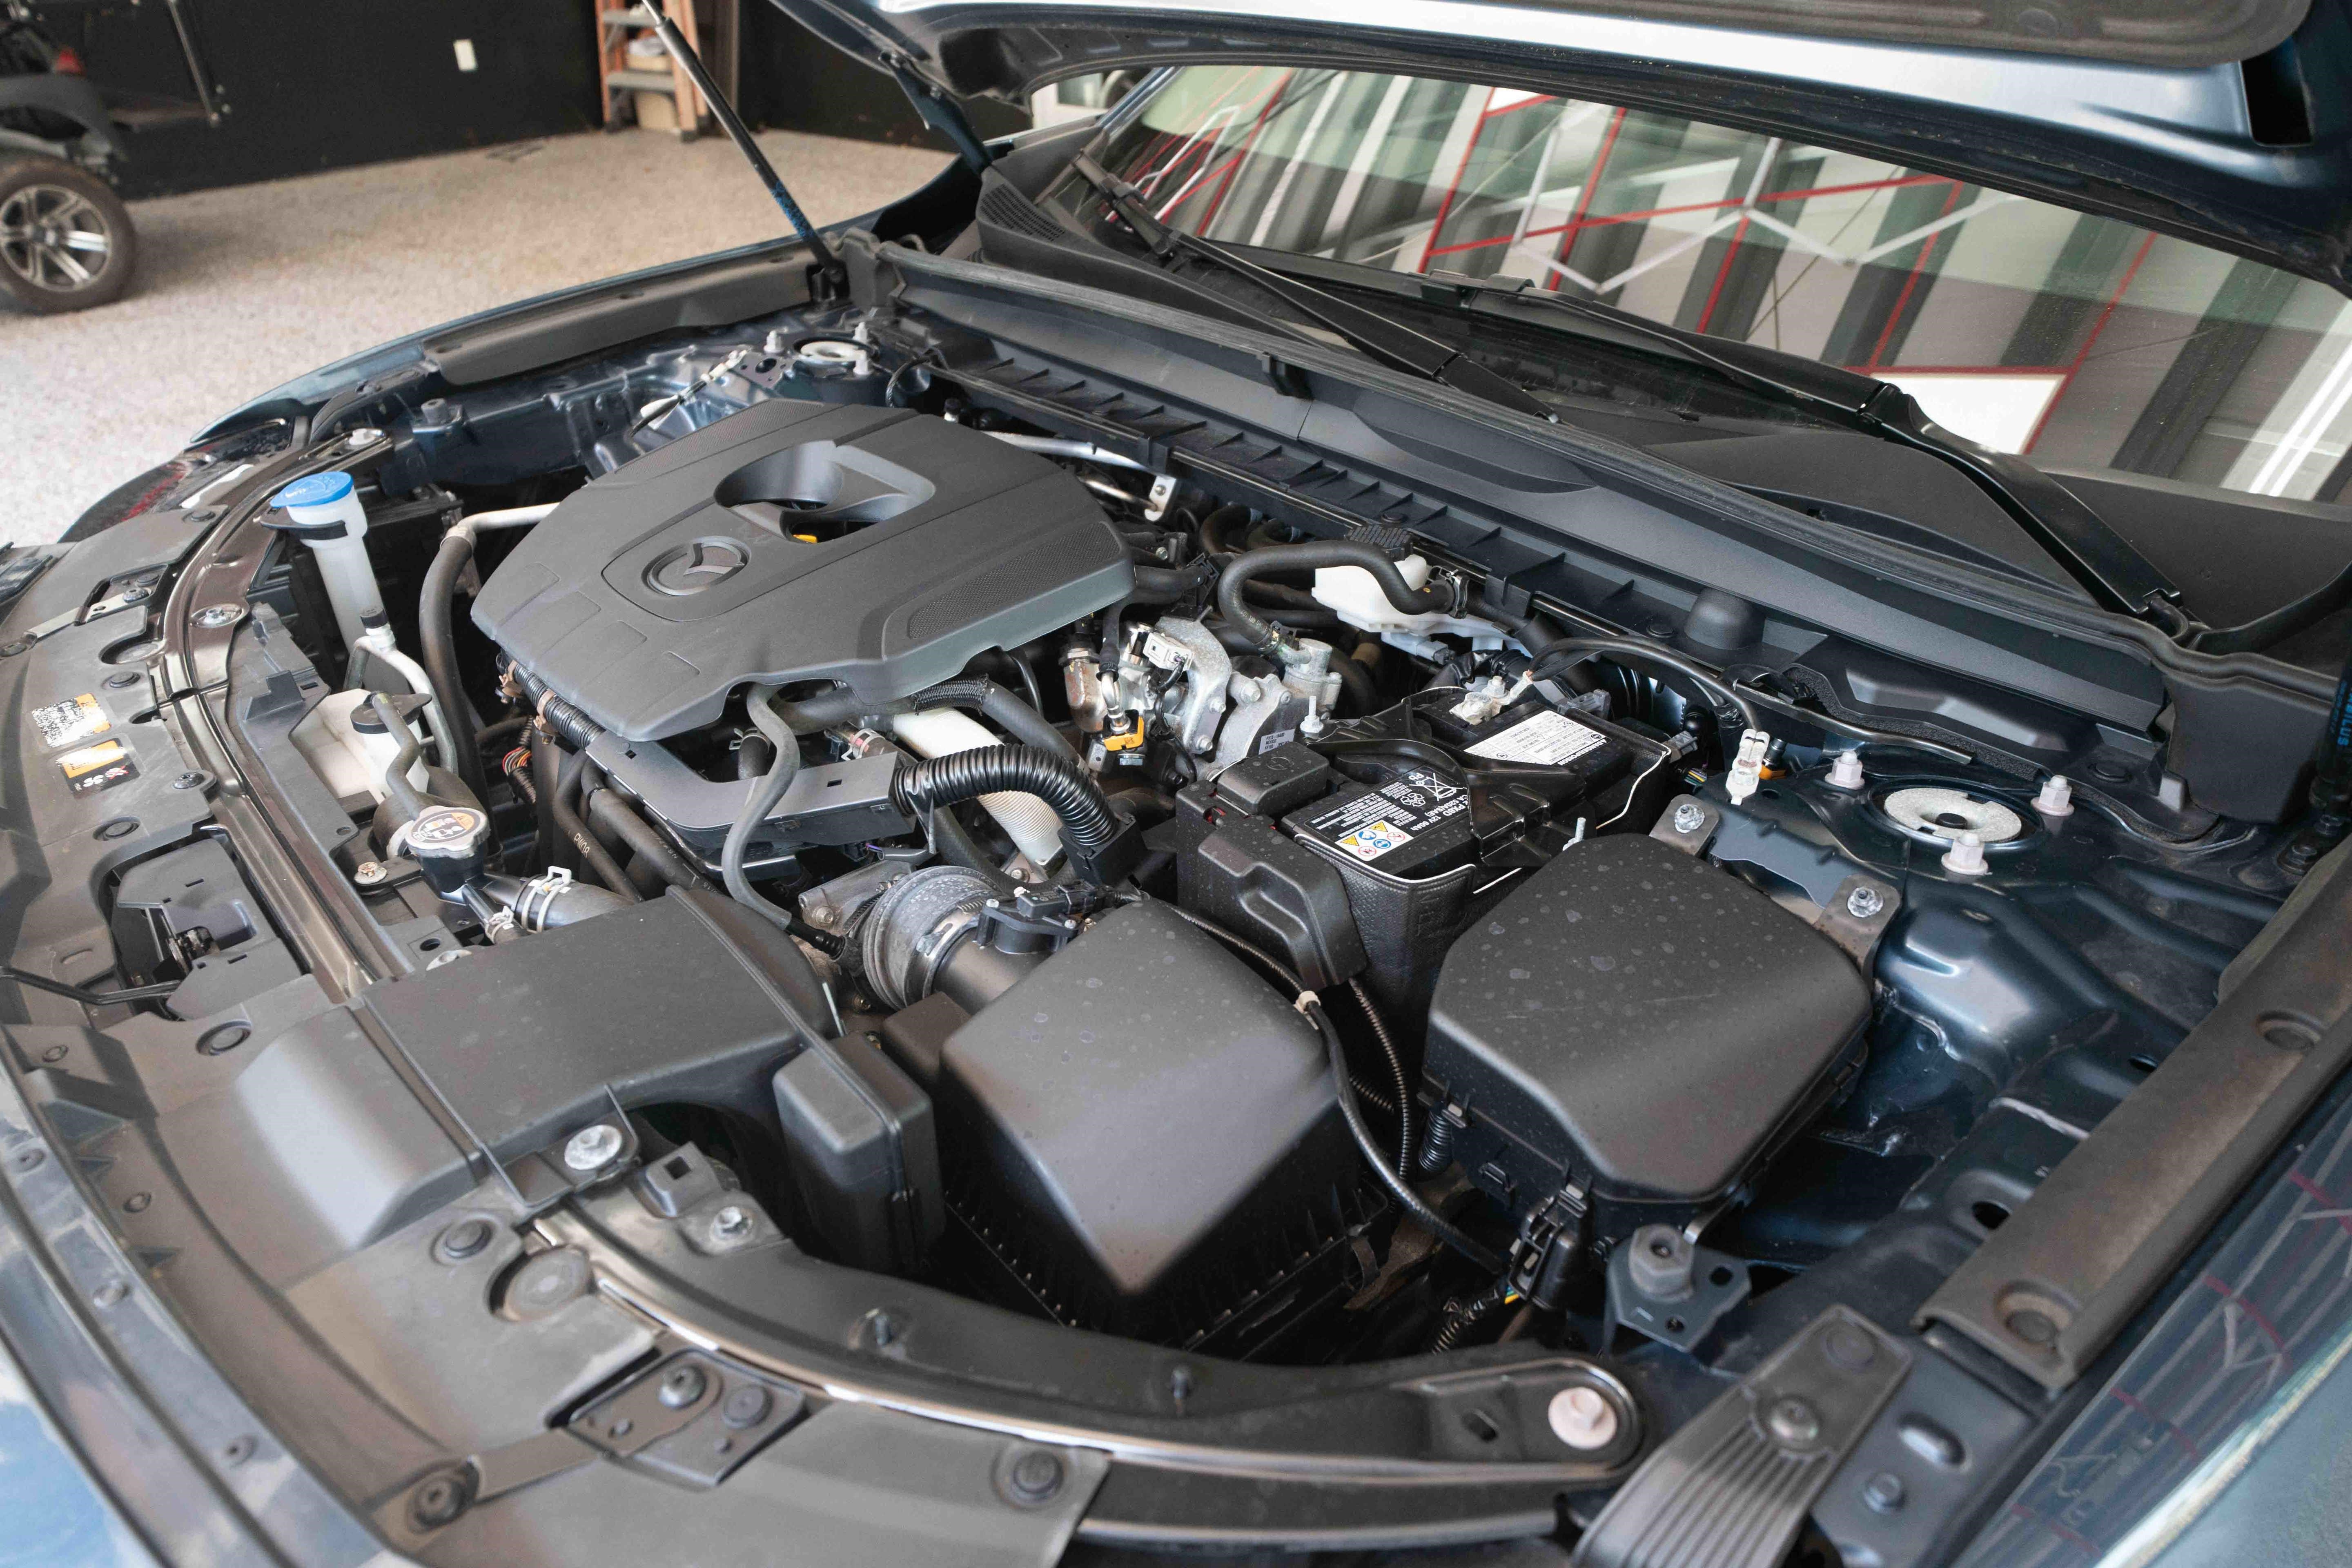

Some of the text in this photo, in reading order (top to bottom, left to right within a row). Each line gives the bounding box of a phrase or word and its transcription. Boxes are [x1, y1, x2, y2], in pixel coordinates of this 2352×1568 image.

[1425, 800, 1459, 817] 520A(SAE)
[1443, 803, 1466, 816] PX8D
[1410, 822, 1430, 831] 60Ah
